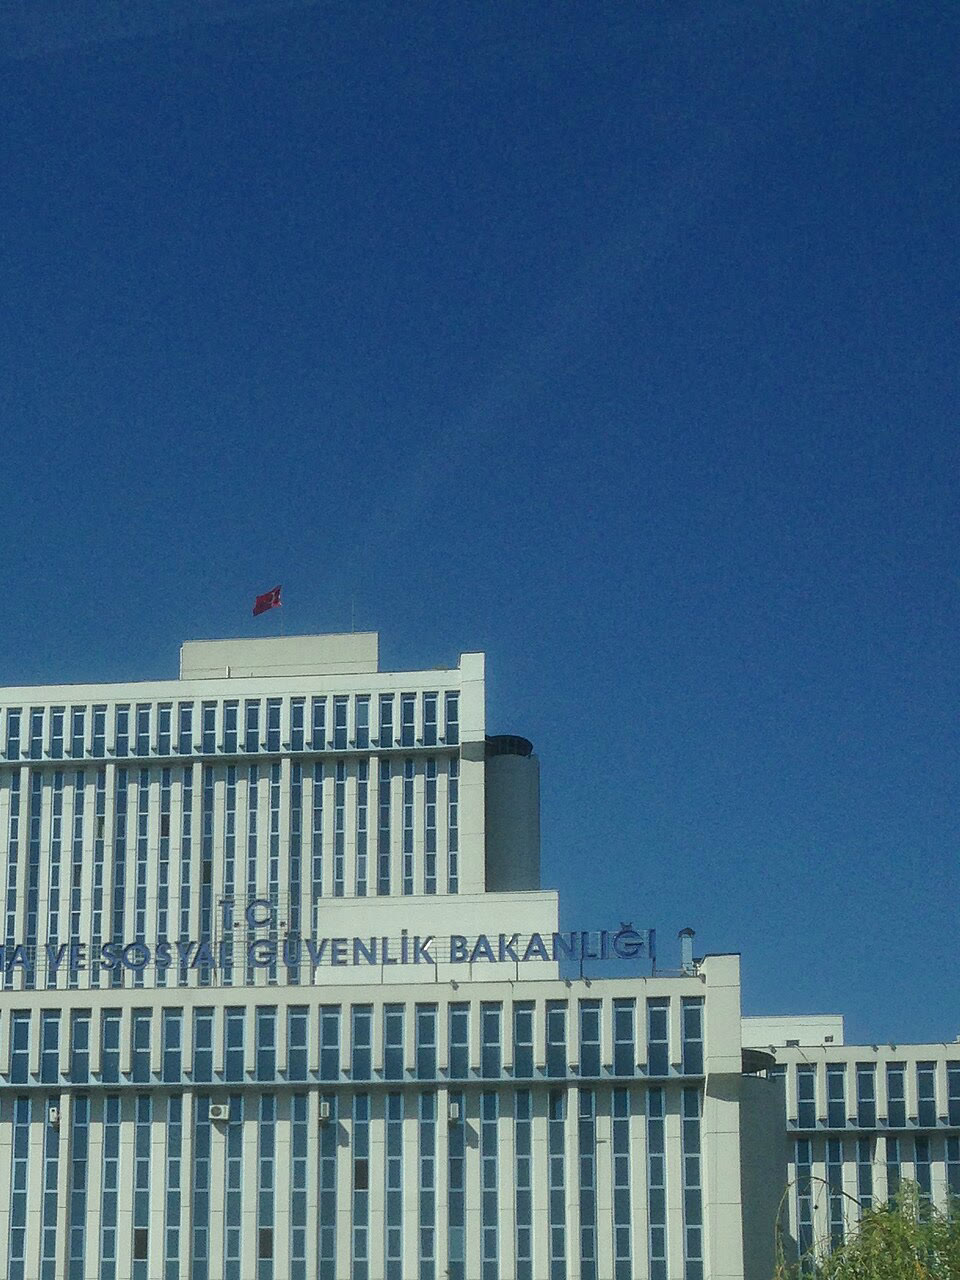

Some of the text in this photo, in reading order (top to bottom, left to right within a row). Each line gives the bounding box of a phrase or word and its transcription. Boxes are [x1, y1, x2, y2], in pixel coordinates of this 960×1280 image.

[45, 942, 86, 971] VE
[100, 940, 234, 971] SOSYAL
[247, 929, 437, 969] GÜVENLİK
[449, 921, 657, 963] BAKANLIĞI
